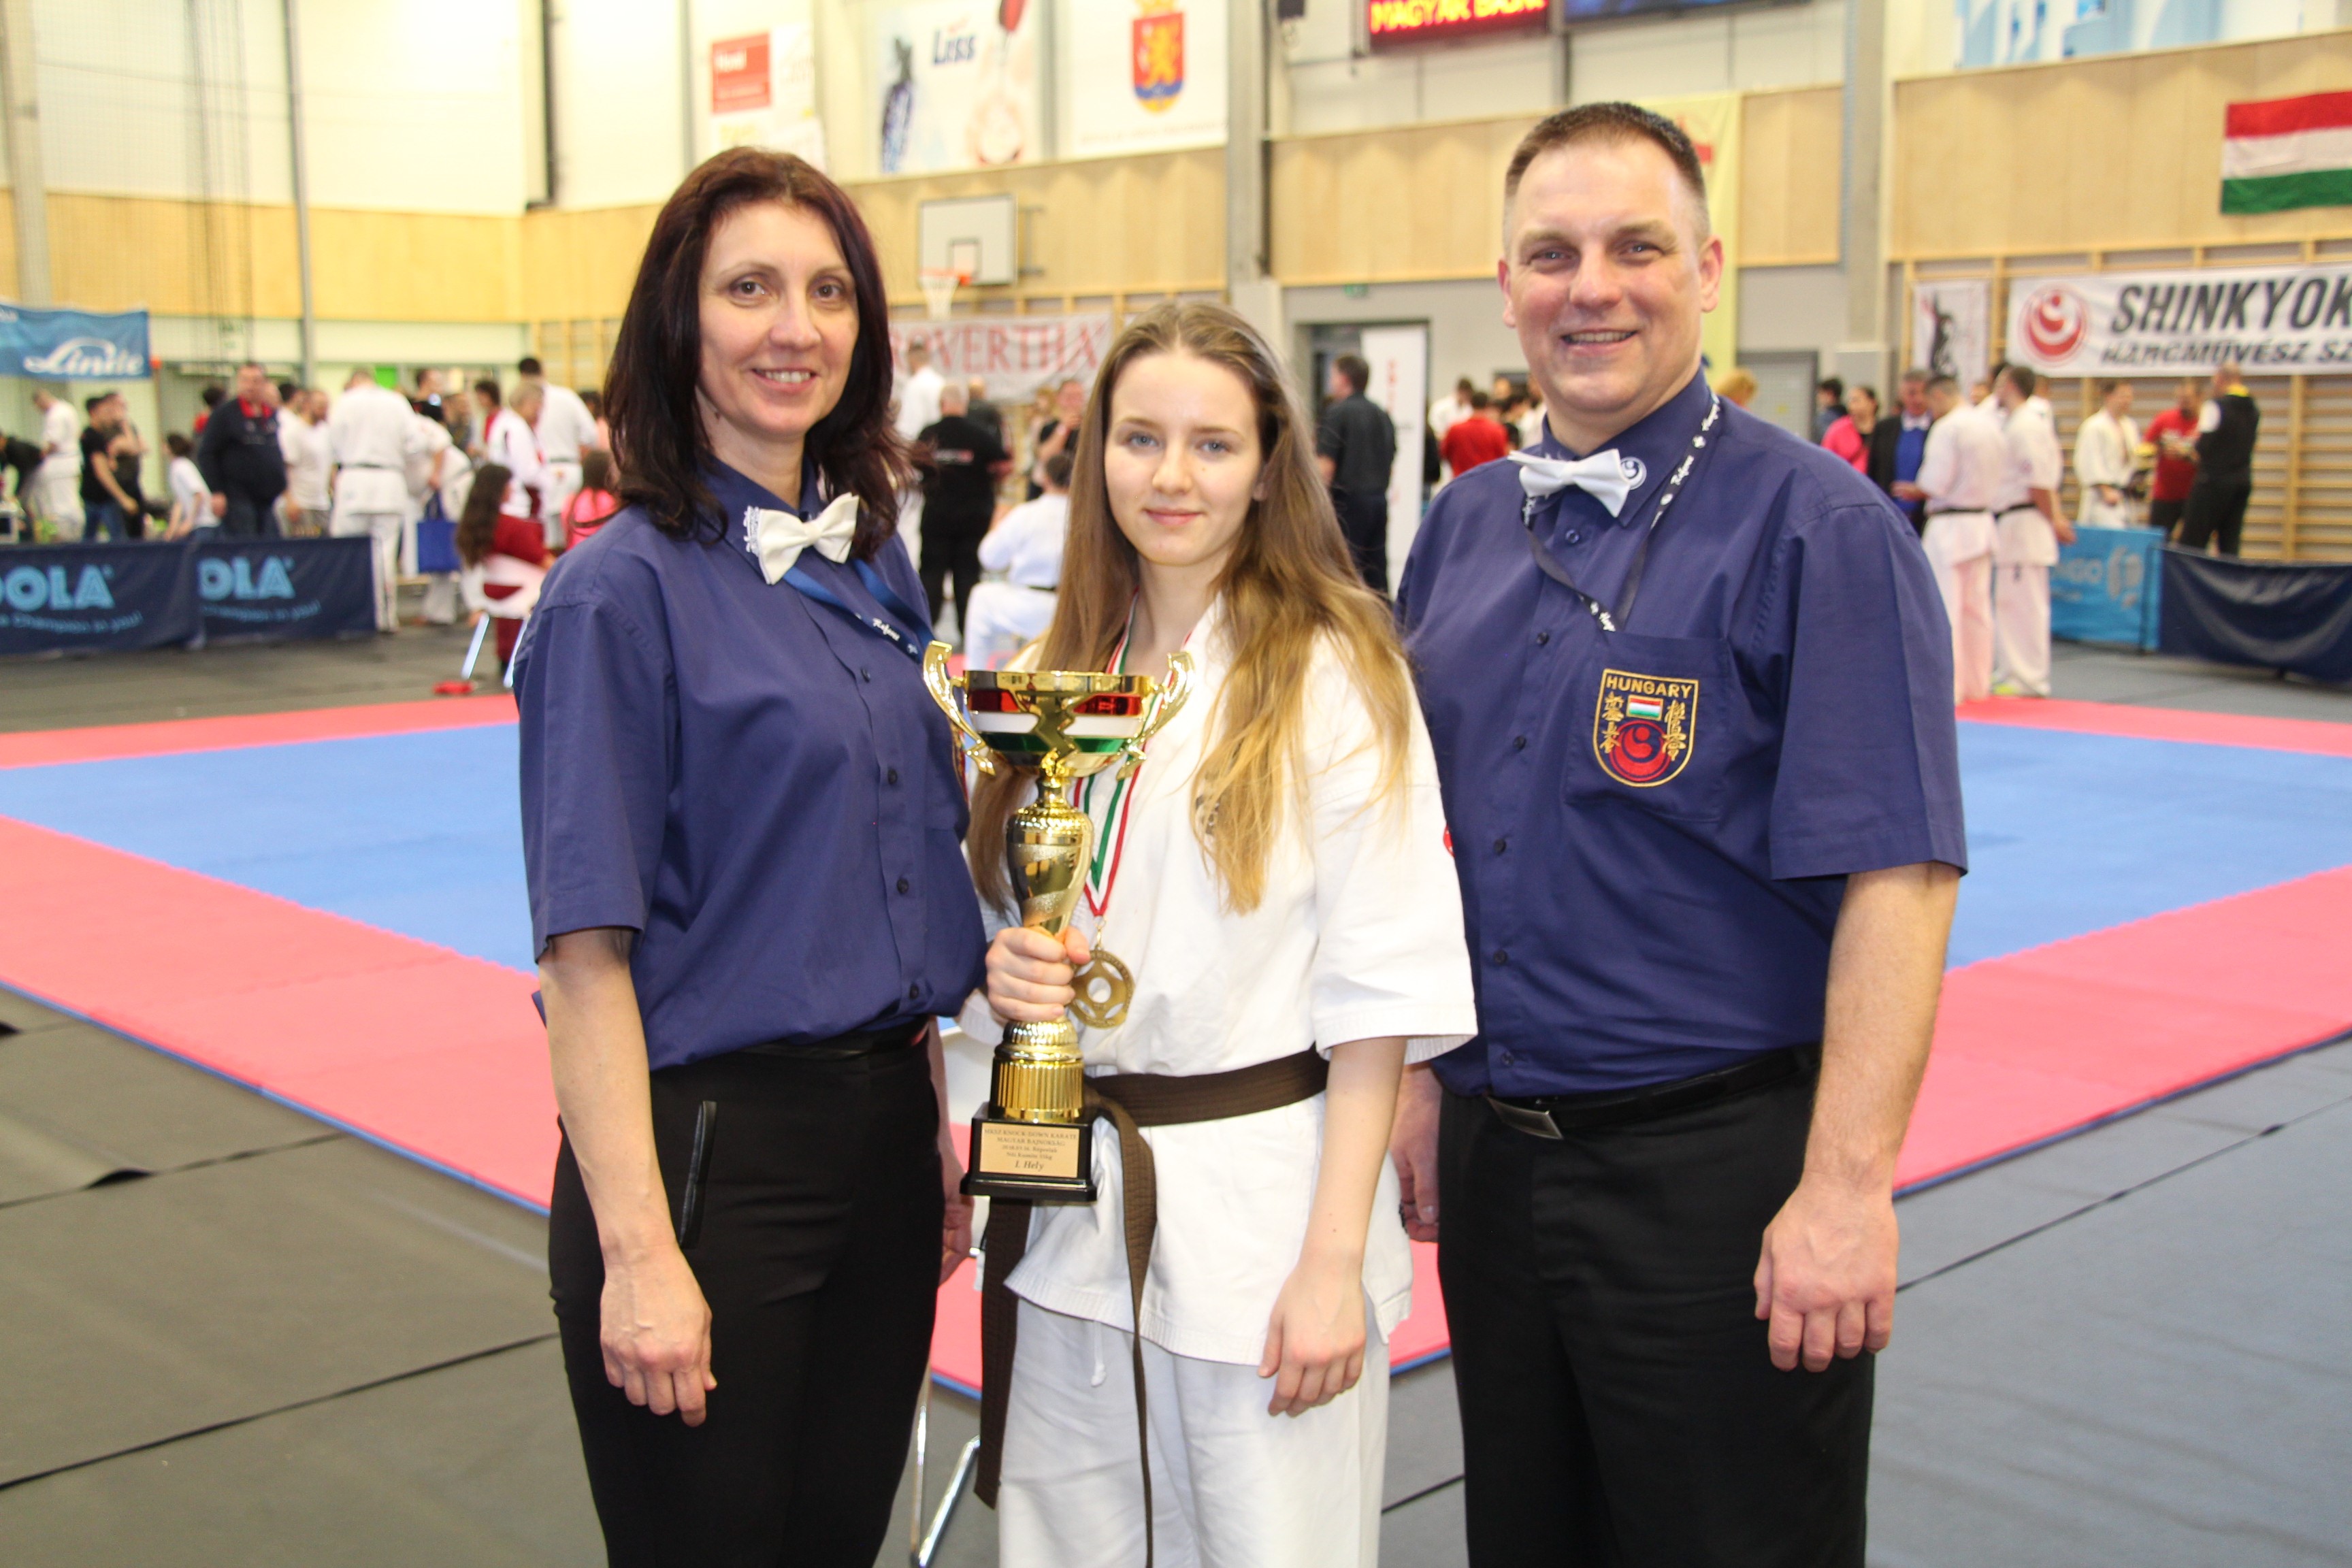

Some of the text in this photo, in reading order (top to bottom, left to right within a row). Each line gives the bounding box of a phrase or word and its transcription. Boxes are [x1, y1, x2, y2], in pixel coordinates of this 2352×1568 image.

[2110, 274, 2352, 333] SHINKYOK
[23, 336, 144, 376] Linde
[0, 564, 116, 612] OLA
[1606, 675, 1693, 699] HUNGARY
[1024, 1160, 1045, 1172] Hely
